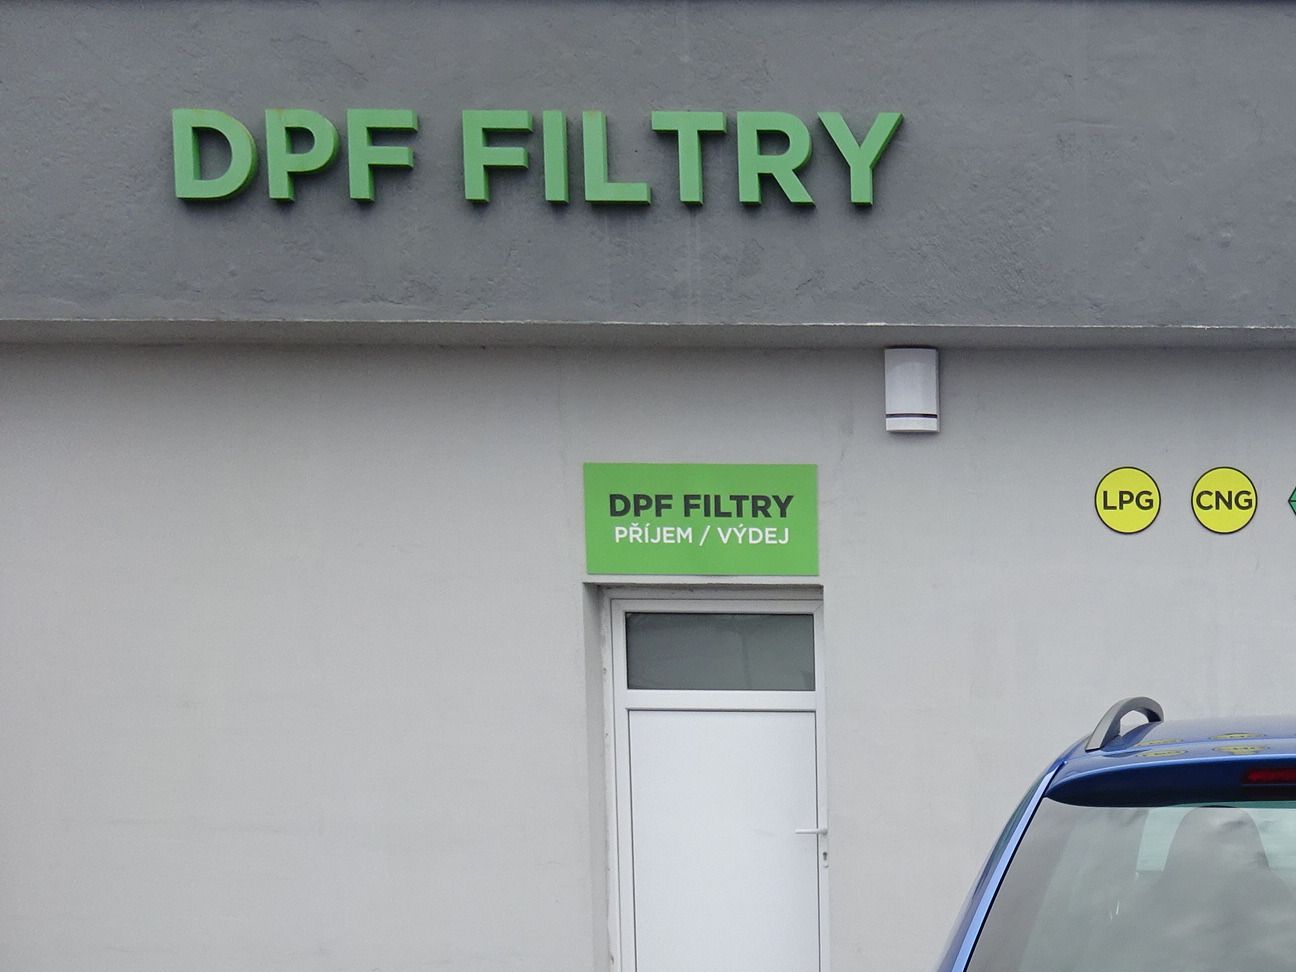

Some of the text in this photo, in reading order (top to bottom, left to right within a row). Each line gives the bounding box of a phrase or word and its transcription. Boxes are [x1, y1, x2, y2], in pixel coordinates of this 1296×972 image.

[171, 109, 903, 207] DPF FILTRY
[609, 494, 794, 518] DPF FILTRY
[1103, 491, 1154, 510] LPG
[1196, 491, 1253, 510] CNG
[615, 523, 789, 546] PŘÍJEM / VÝDEJ
